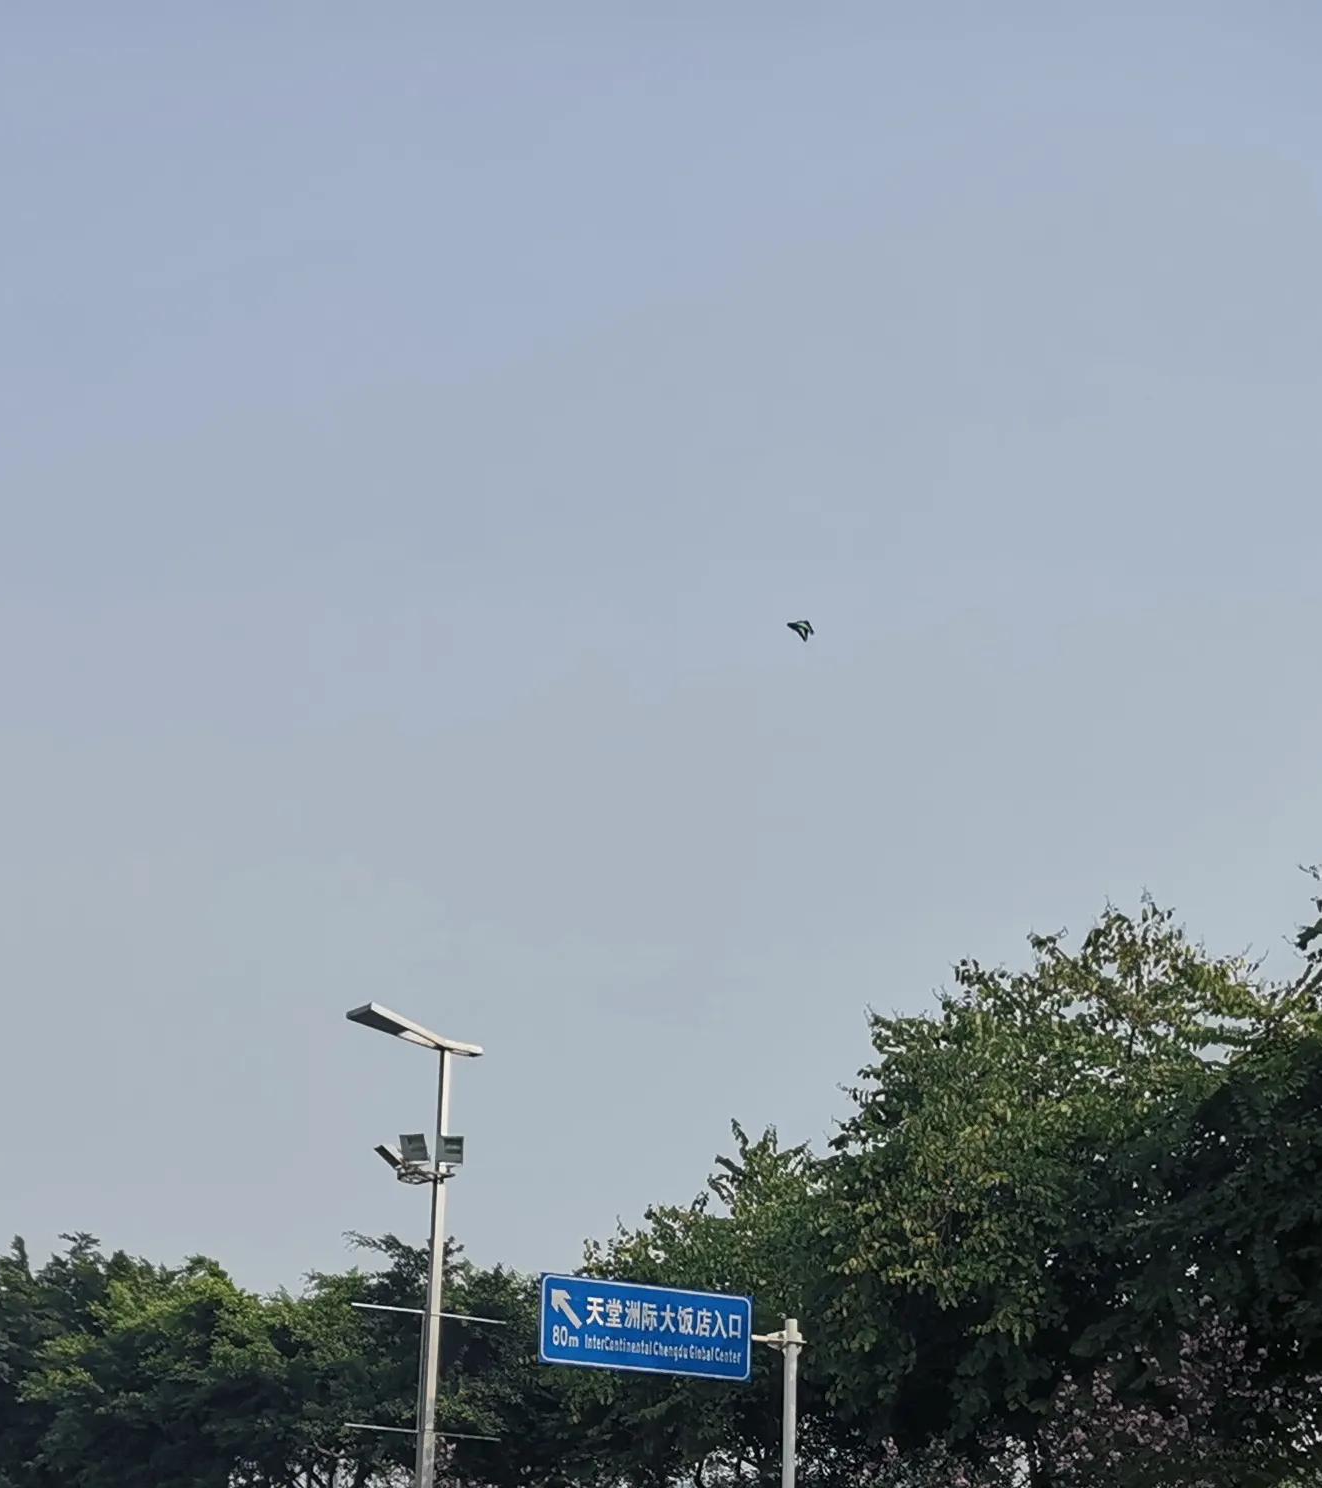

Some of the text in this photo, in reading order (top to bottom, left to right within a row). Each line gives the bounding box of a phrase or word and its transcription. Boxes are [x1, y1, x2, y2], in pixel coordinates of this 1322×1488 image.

[586, 1296, 742, 1339] 天堂洲际大饭店入口
[552, 1325, 579, 1348] 80m
[584, 1334, 742, 1365] InterContinental Chengdu Global Center
